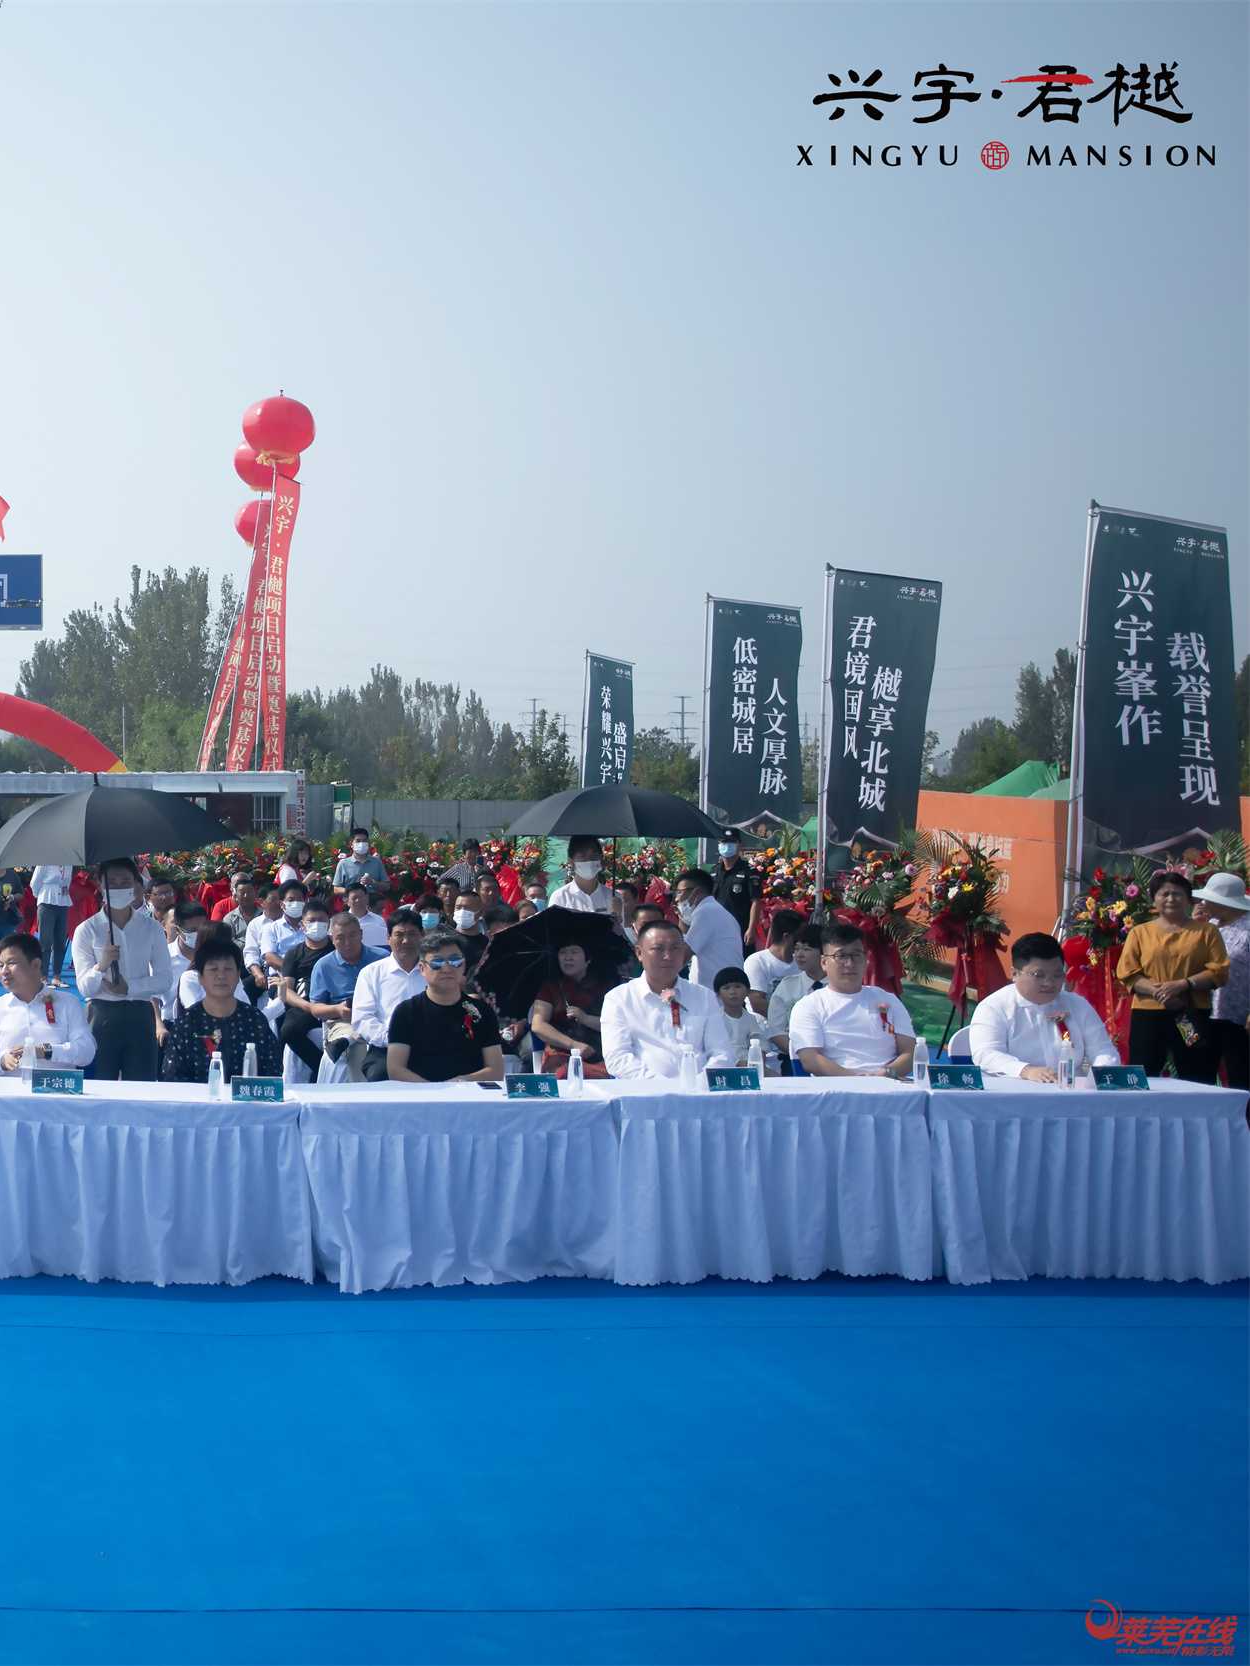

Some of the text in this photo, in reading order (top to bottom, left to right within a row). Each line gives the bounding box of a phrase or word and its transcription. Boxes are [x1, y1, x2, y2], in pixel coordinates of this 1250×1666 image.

[600, 685, 612, 784] 荣耀兴宇
[732, 636, 758, 754] 低密城居
[758, 677, 788, 796] 人文厚脉
[843, 615, 877, 760] 君境国风
[857, 666, 903, 813] 樾享北城
[1166, 631, 1221, 807] 载誉呈现
